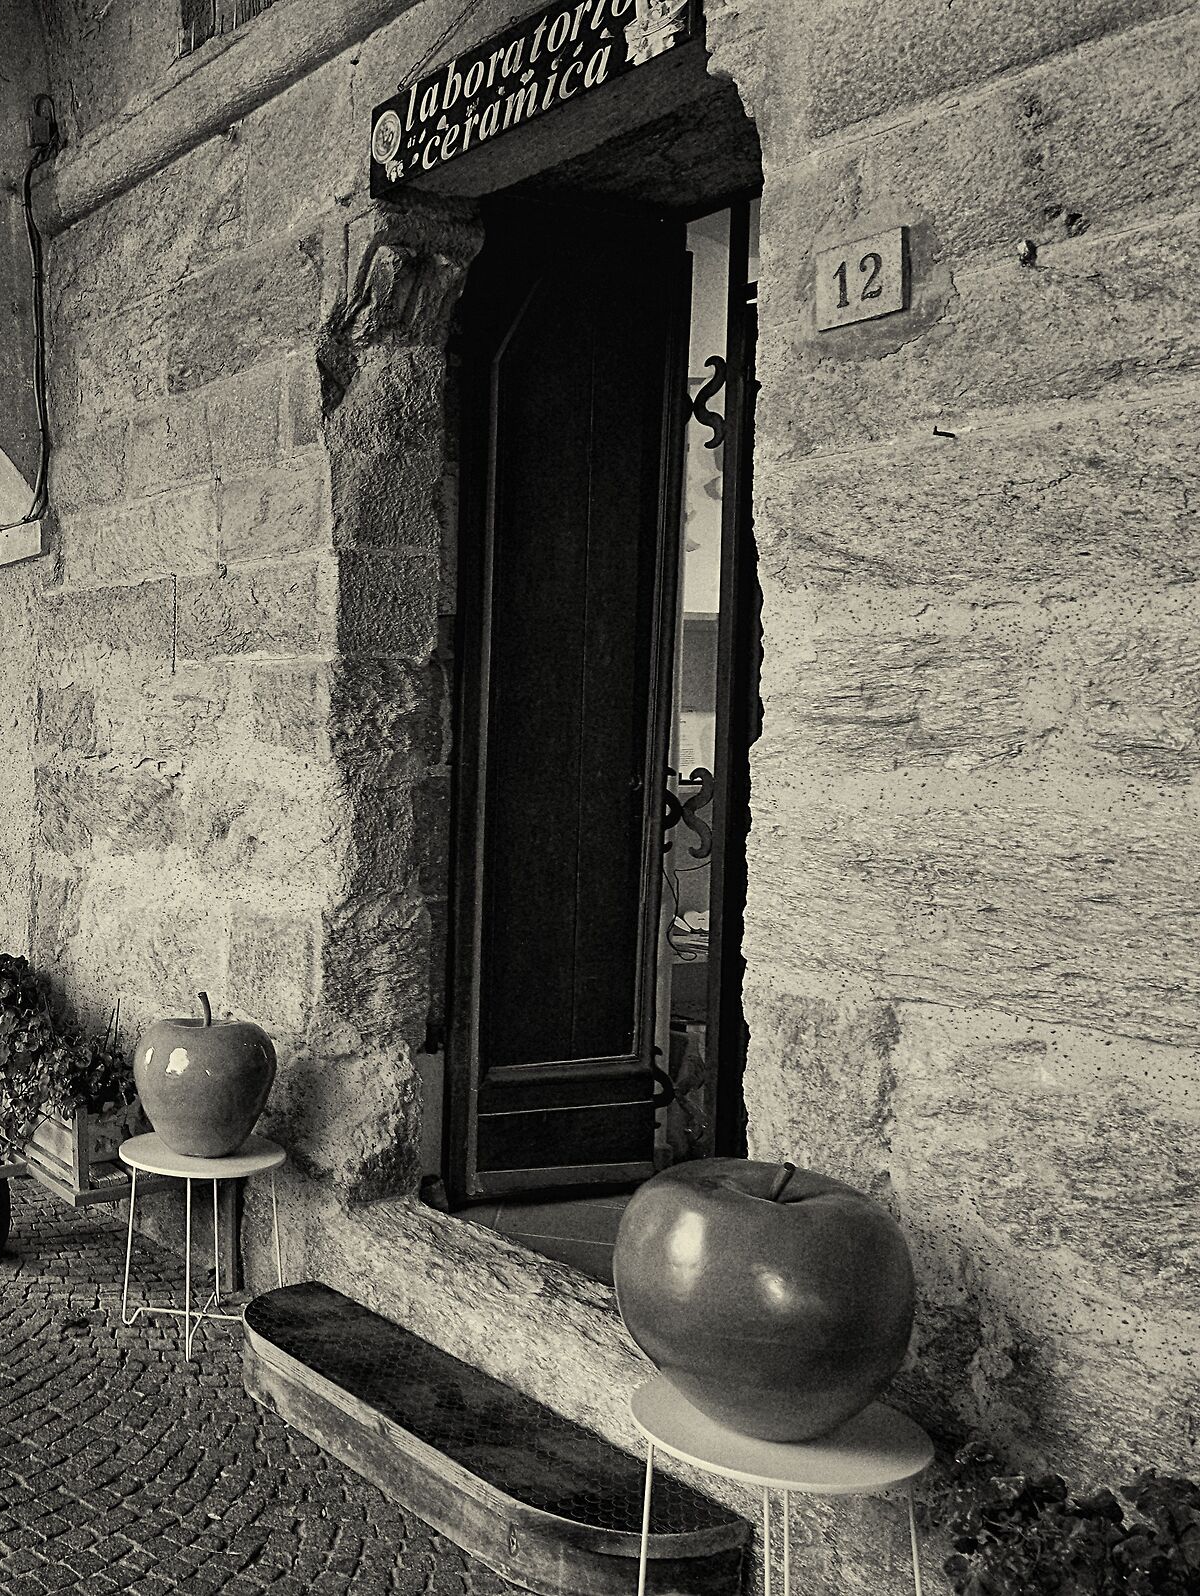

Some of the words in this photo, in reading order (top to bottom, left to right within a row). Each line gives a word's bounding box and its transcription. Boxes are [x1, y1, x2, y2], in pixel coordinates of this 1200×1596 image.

[407, 135, 417, 149] di
[422, 44, 612, 170] ceramica
[832, 252, 883, 309] 12
